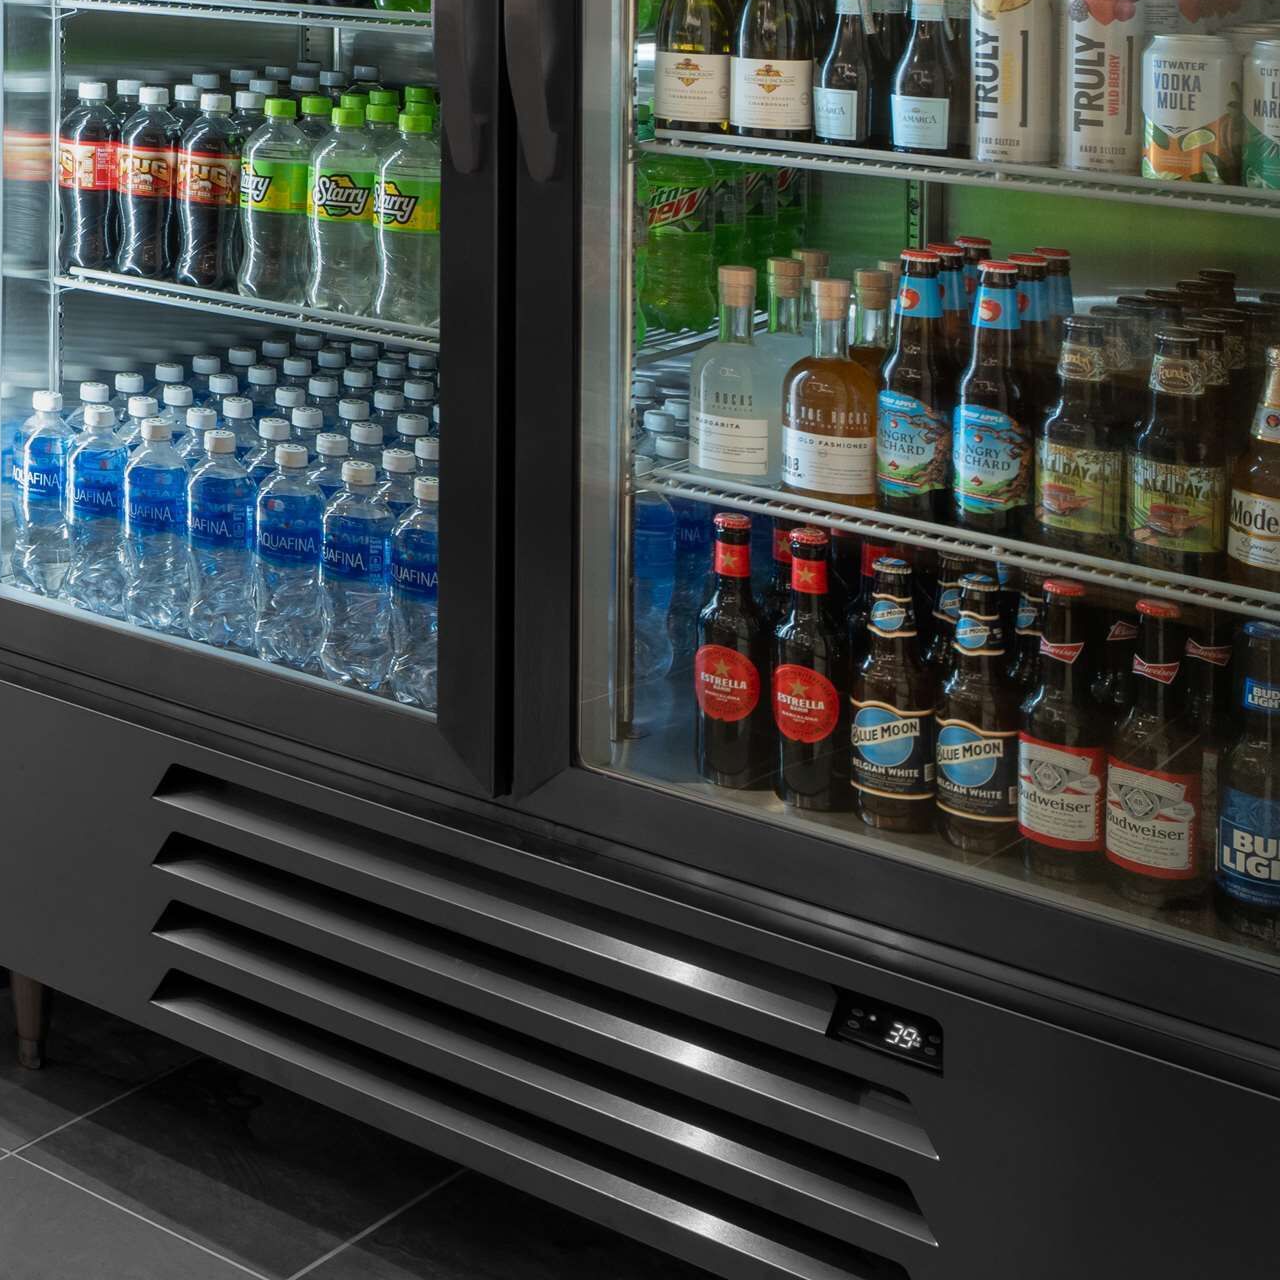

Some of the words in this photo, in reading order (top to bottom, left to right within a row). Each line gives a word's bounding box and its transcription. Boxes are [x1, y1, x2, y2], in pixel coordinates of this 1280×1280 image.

[974, 29, 1000, 124] TRULY
[1073, 33, 1106, 133] TRULY
[1153, 71, 1202, 94] VODKA
[1156, 92, 1196, 112] MULE
[313, 176, 372, 212] Starry
[798, 436, 815, 445] OLD
[817, 439, 869, 449] FASHIONED
[1231, 499, 1280, 535] Mode
[256, 530, 317, 553] AQUAFINA
[700, 671, 748, 691] ESTRELLA
[776, 692, 825, 711] ESTRELLA
[880, 722, 919, 738] MOON
[960, 740, 1003, 757] MOON
[888, 766, 920, 778] WHITE
[968, 787, 1003, 801] WHITE
[1018, 786, 1092, 814] Budweiser
[1106, 812, 1186, 841] Budweiser
[1233, 830, 1280, 861] BU
[885, 1022, 917, 1048] 39
